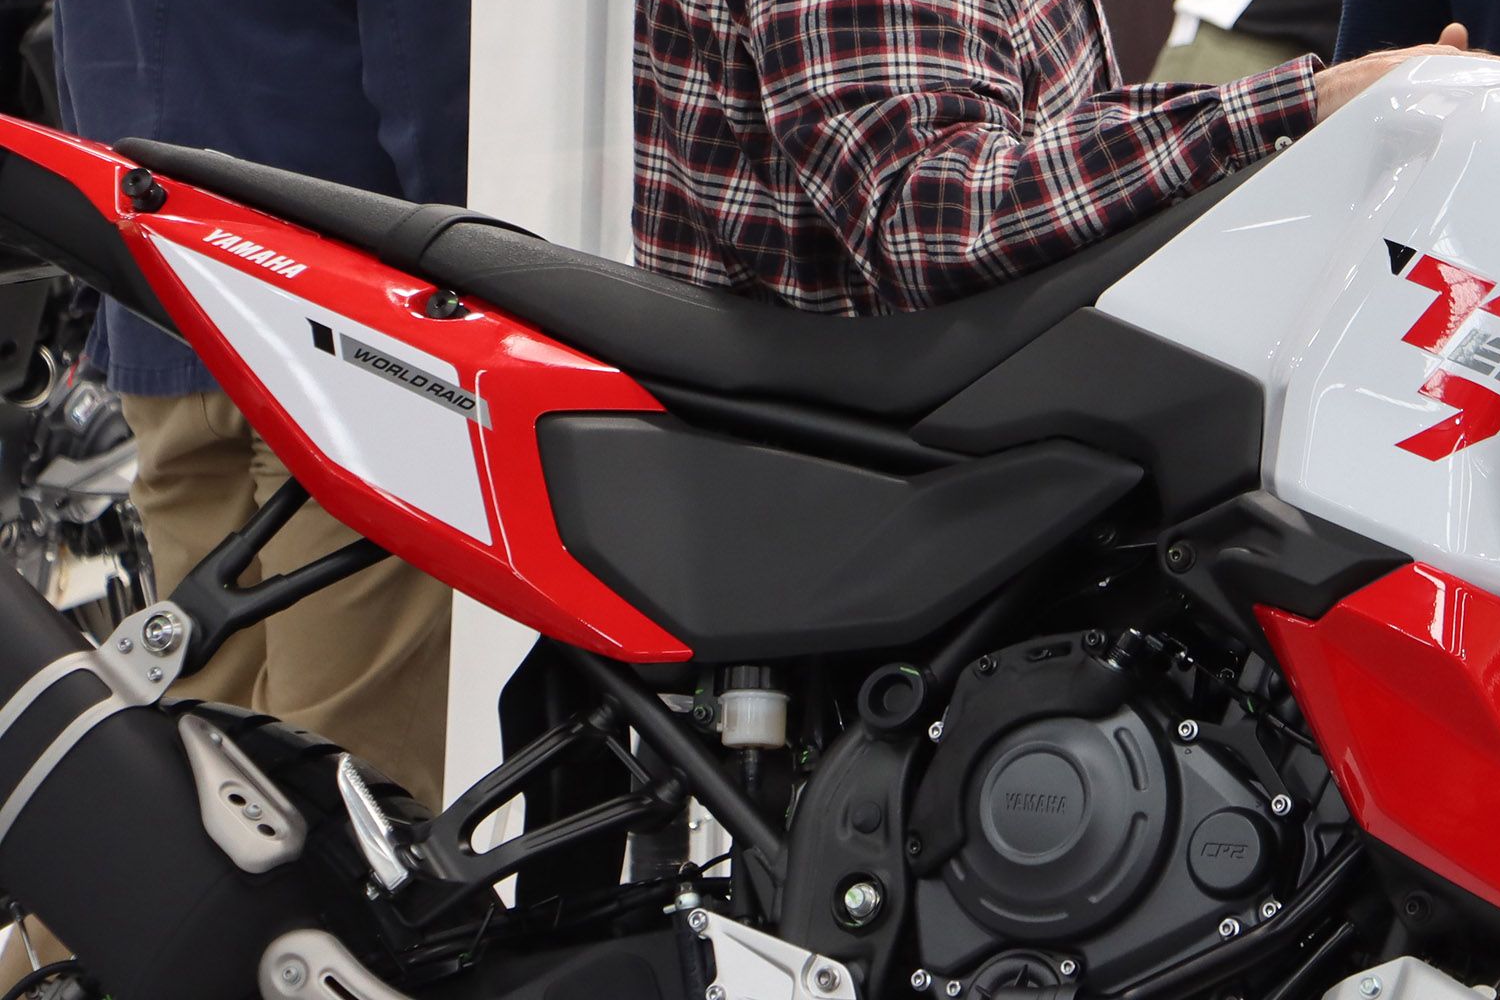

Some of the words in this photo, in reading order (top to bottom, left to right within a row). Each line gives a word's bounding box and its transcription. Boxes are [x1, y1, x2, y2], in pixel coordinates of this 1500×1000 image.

[201, 227, 309, 279] YAMAHA
[353, 348, 428, 388] WORLD
[425, 382, 477, 411] RAID
[1005, 791, 1068, 816] YAMAHA
